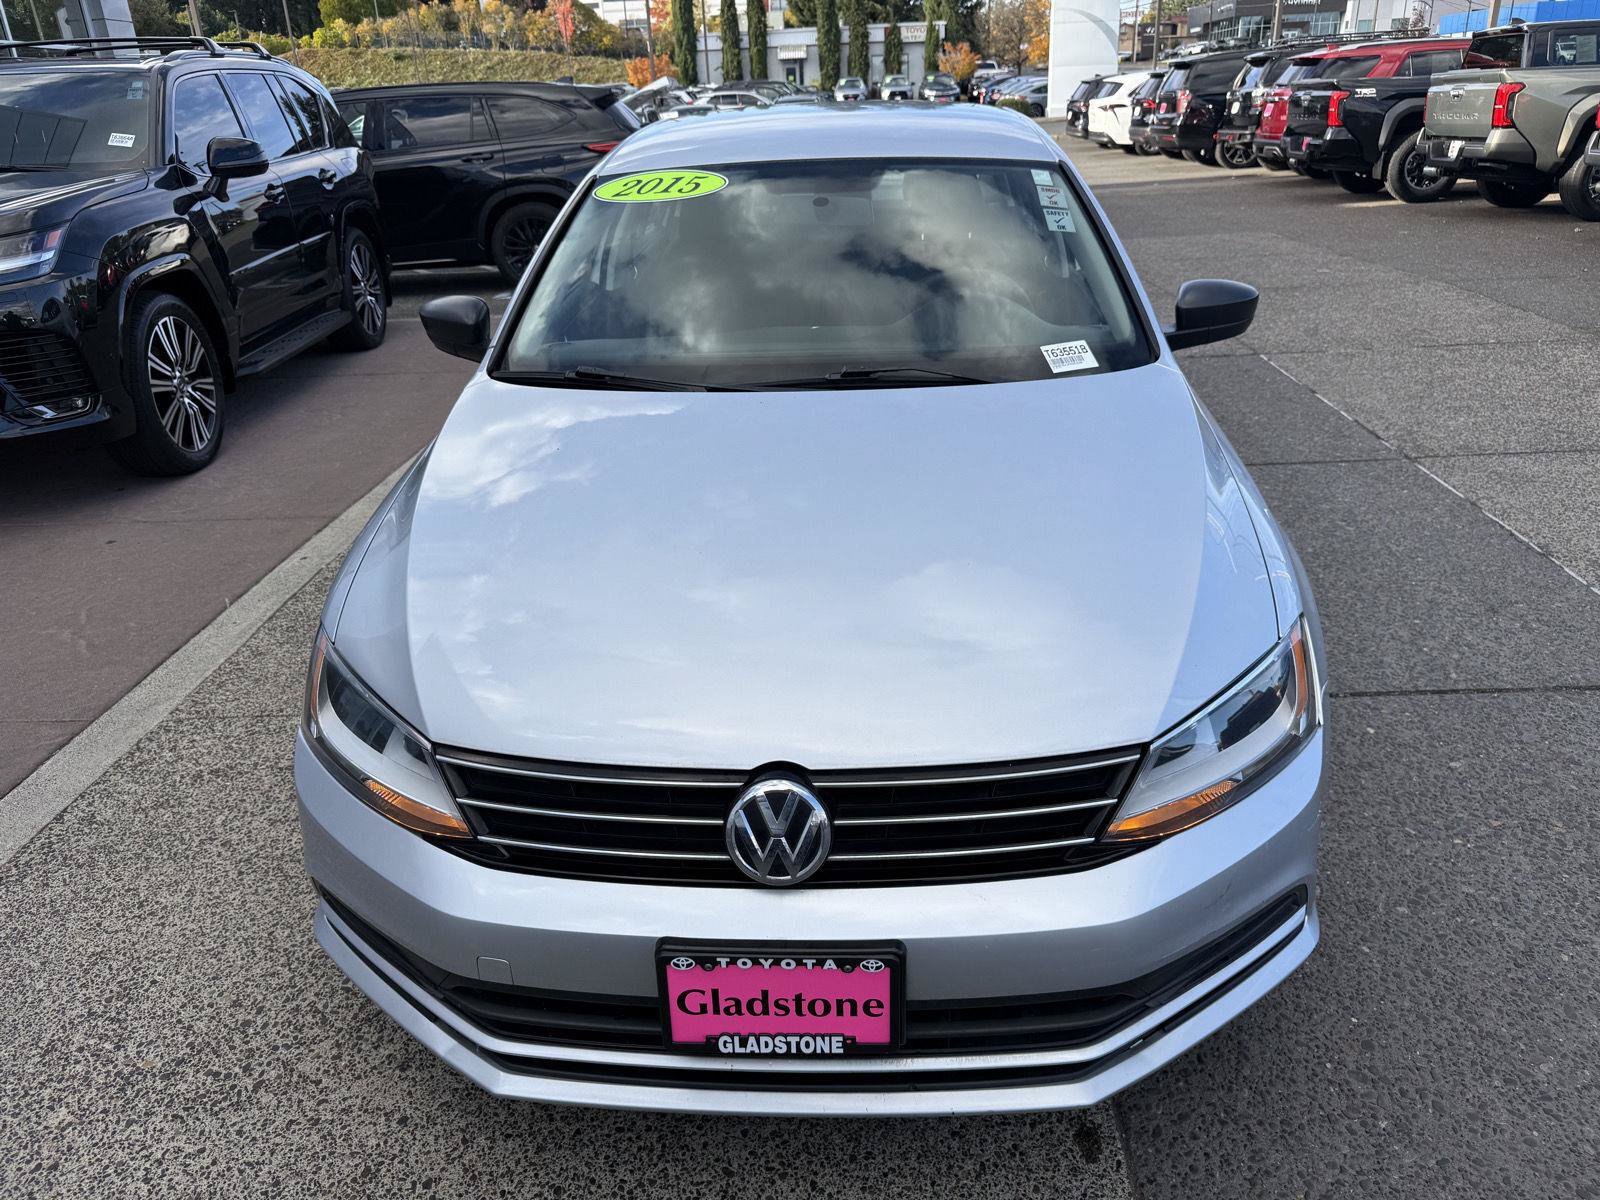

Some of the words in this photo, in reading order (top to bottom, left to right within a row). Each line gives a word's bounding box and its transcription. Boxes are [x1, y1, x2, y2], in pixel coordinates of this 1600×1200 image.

[611, 175, 710, 198] 2015
[716, 957, 838, 970] TOYOTA
[676, 988, 885, 1018] Gladstone
[717, 1035, 845, 1055] GLADSTONE
